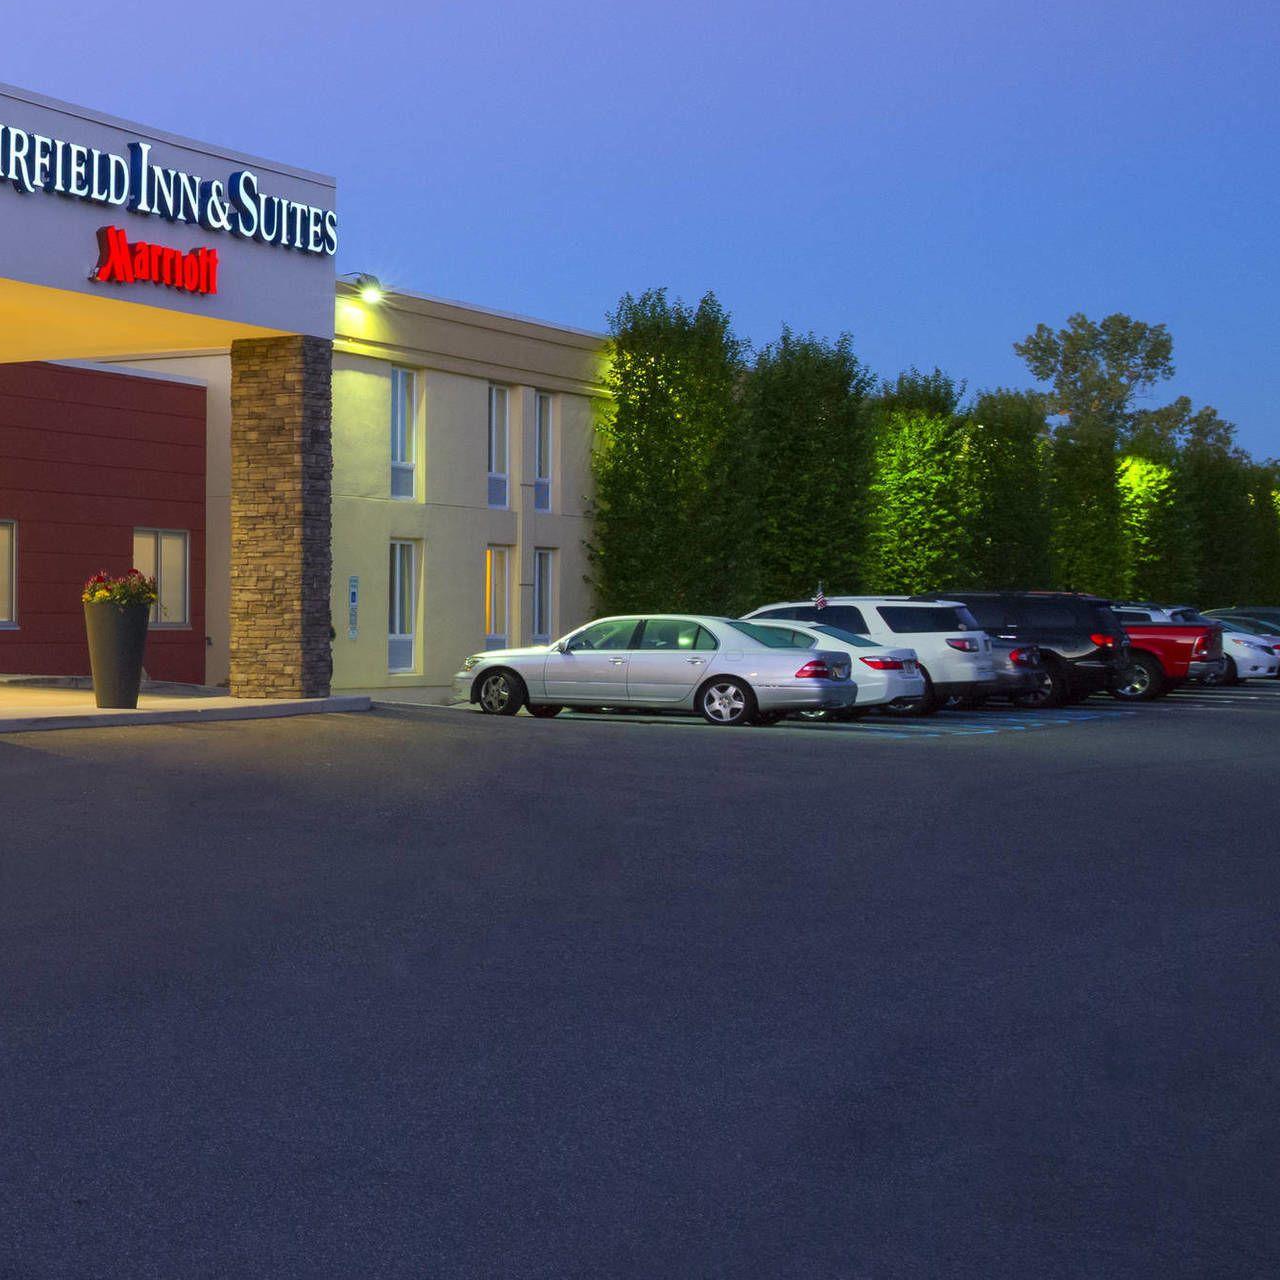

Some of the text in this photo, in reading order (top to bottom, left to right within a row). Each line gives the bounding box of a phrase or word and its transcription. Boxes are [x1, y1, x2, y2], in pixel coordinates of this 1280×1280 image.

[137, 142, 202, 223] INN
[206, 179, 232, 231] &
[238, 170, 338, 256] SUITES
[95, 224, 218, 295] Marriott
